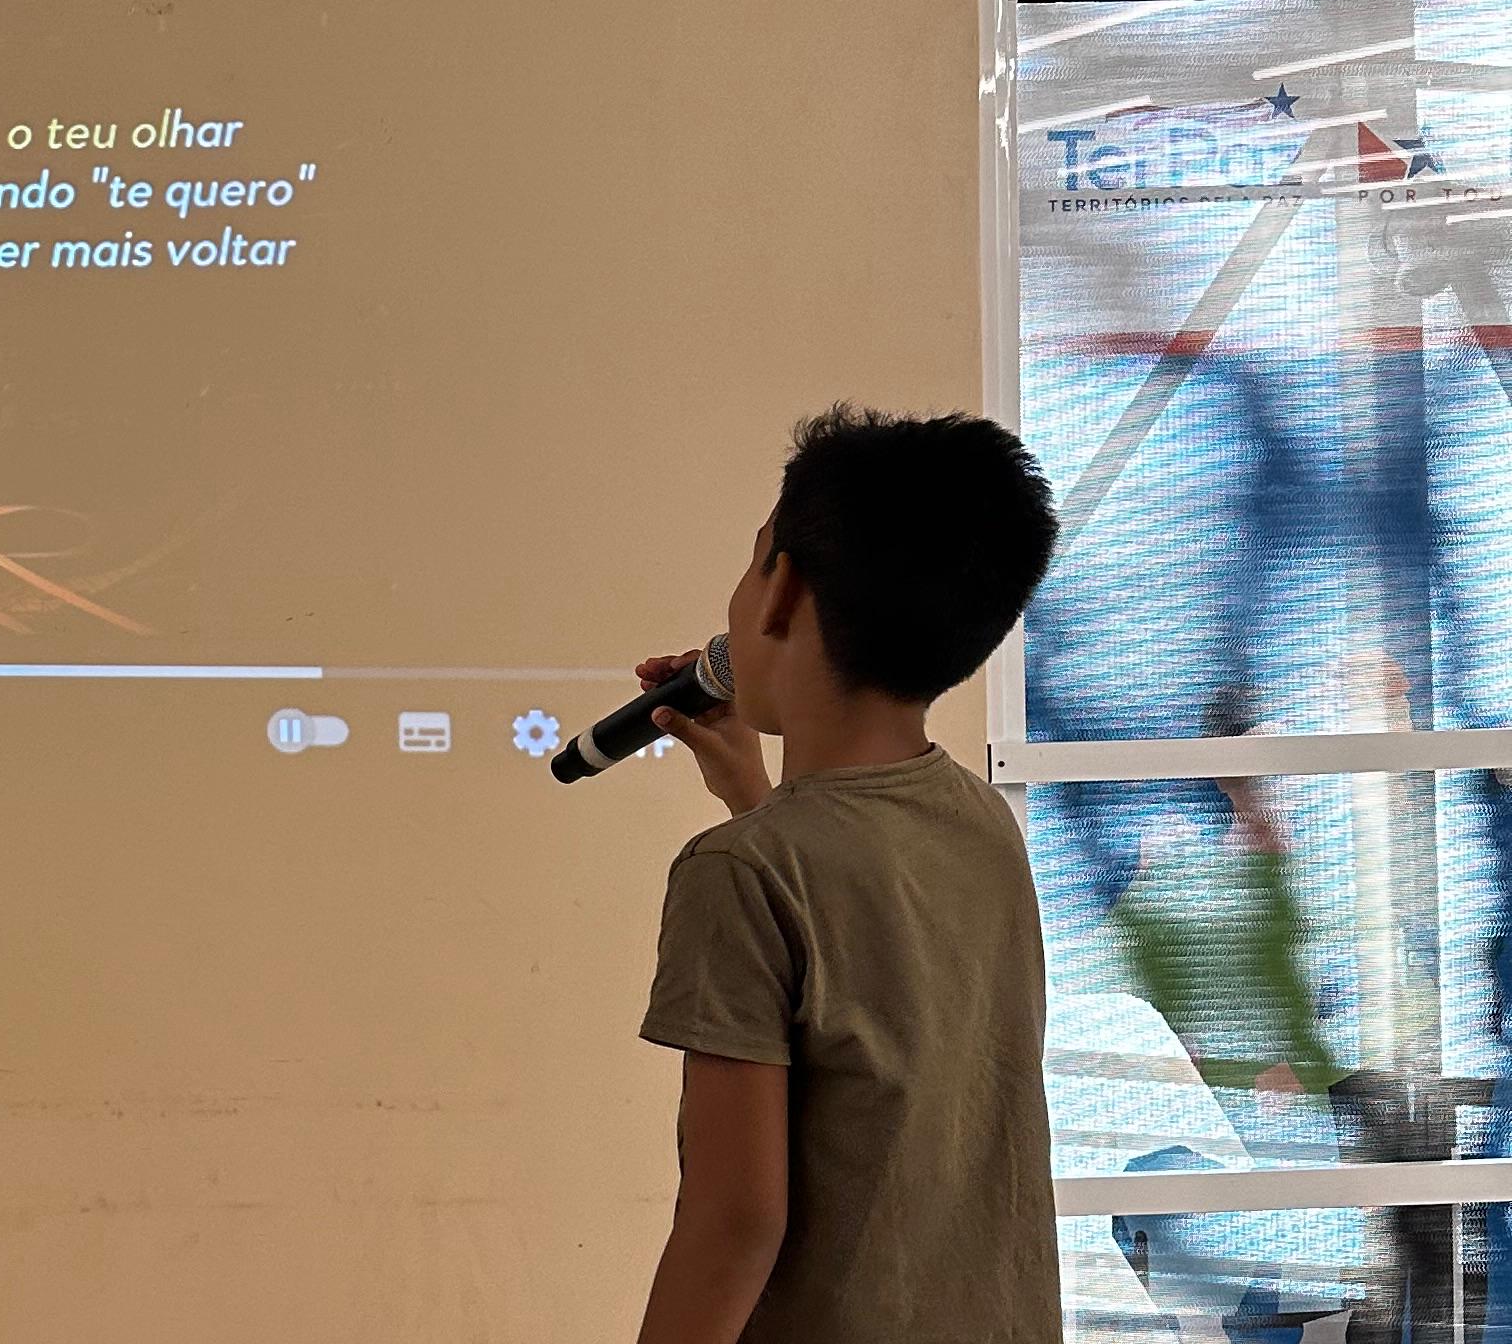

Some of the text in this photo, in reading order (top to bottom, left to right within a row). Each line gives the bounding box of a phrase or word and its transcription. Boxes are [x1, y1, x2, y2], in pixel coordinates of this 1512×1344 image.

[7, 124, 33, 151] o
[47, 118, 118, 151] teu
[131, 107, 245, 149] olhar
[91, 165, 154, 209] "te
[164, 162, 318, 220] quero"
[1358, 189, 1417, 204] POR
[50, 230, 154, 269] mais
[166, 225, 298, 268] voltar
